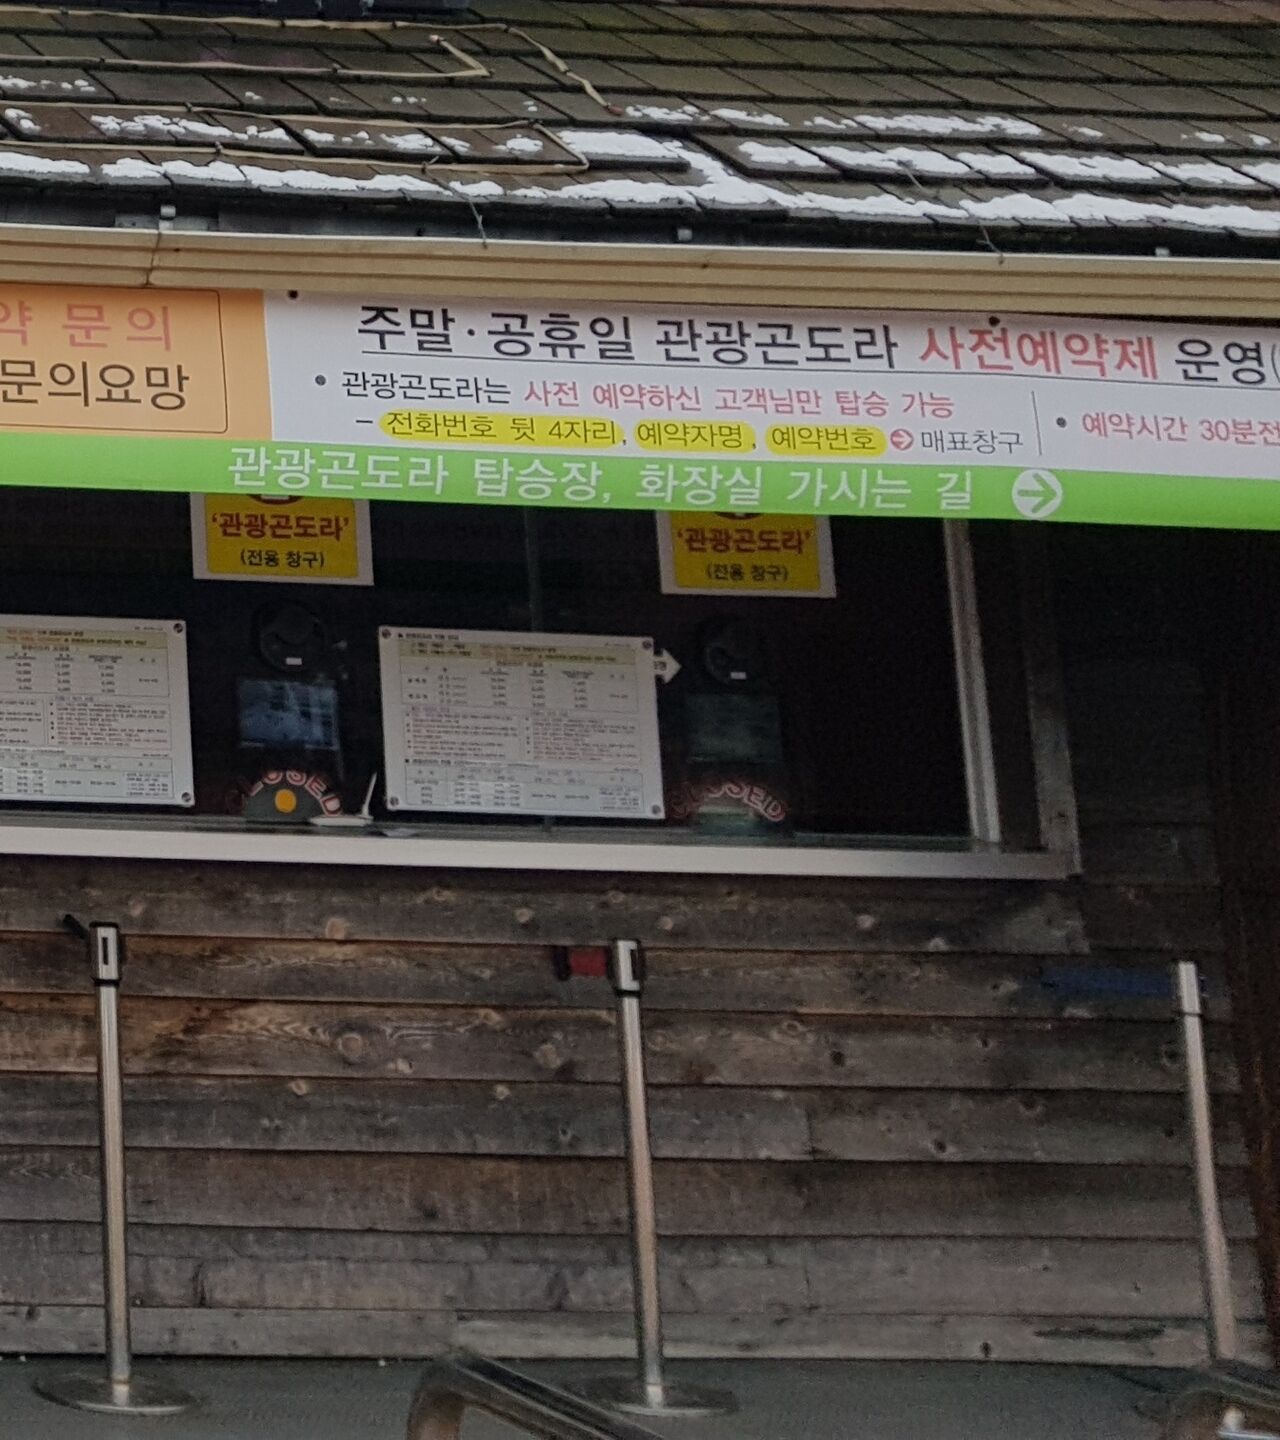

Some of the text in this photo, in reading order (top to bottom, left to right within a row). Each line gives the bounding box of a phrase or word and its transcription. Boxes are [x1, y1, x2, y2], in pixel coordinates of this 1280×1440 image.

[62, 303, 172, 351] 문의
[358, 305, 635, 361] 주말·공휴일
[656, 317, 898, 369] 관광곤도라
[919, 324, 1159, 380] 사전예약제
[342, 371, 954, 419] 관광곤도라는 사전 예약하신 고객님만 탑승 가능
[387, 412, 496, 439] 전화번호
[510, 417, 536, 442] 뒷
[771, 426, 877, 452] 예약번호
[921, 430, 1023, 455] 매표창구
[1082, 412, 1188, 443] 예약시간
[228, 446, 972, 511] 관광곤도라 탑승장, 화장실 가시는 길
[240, 548, 324, 569] (전용 창구)
[751, 564, 788, 582] 창구)
